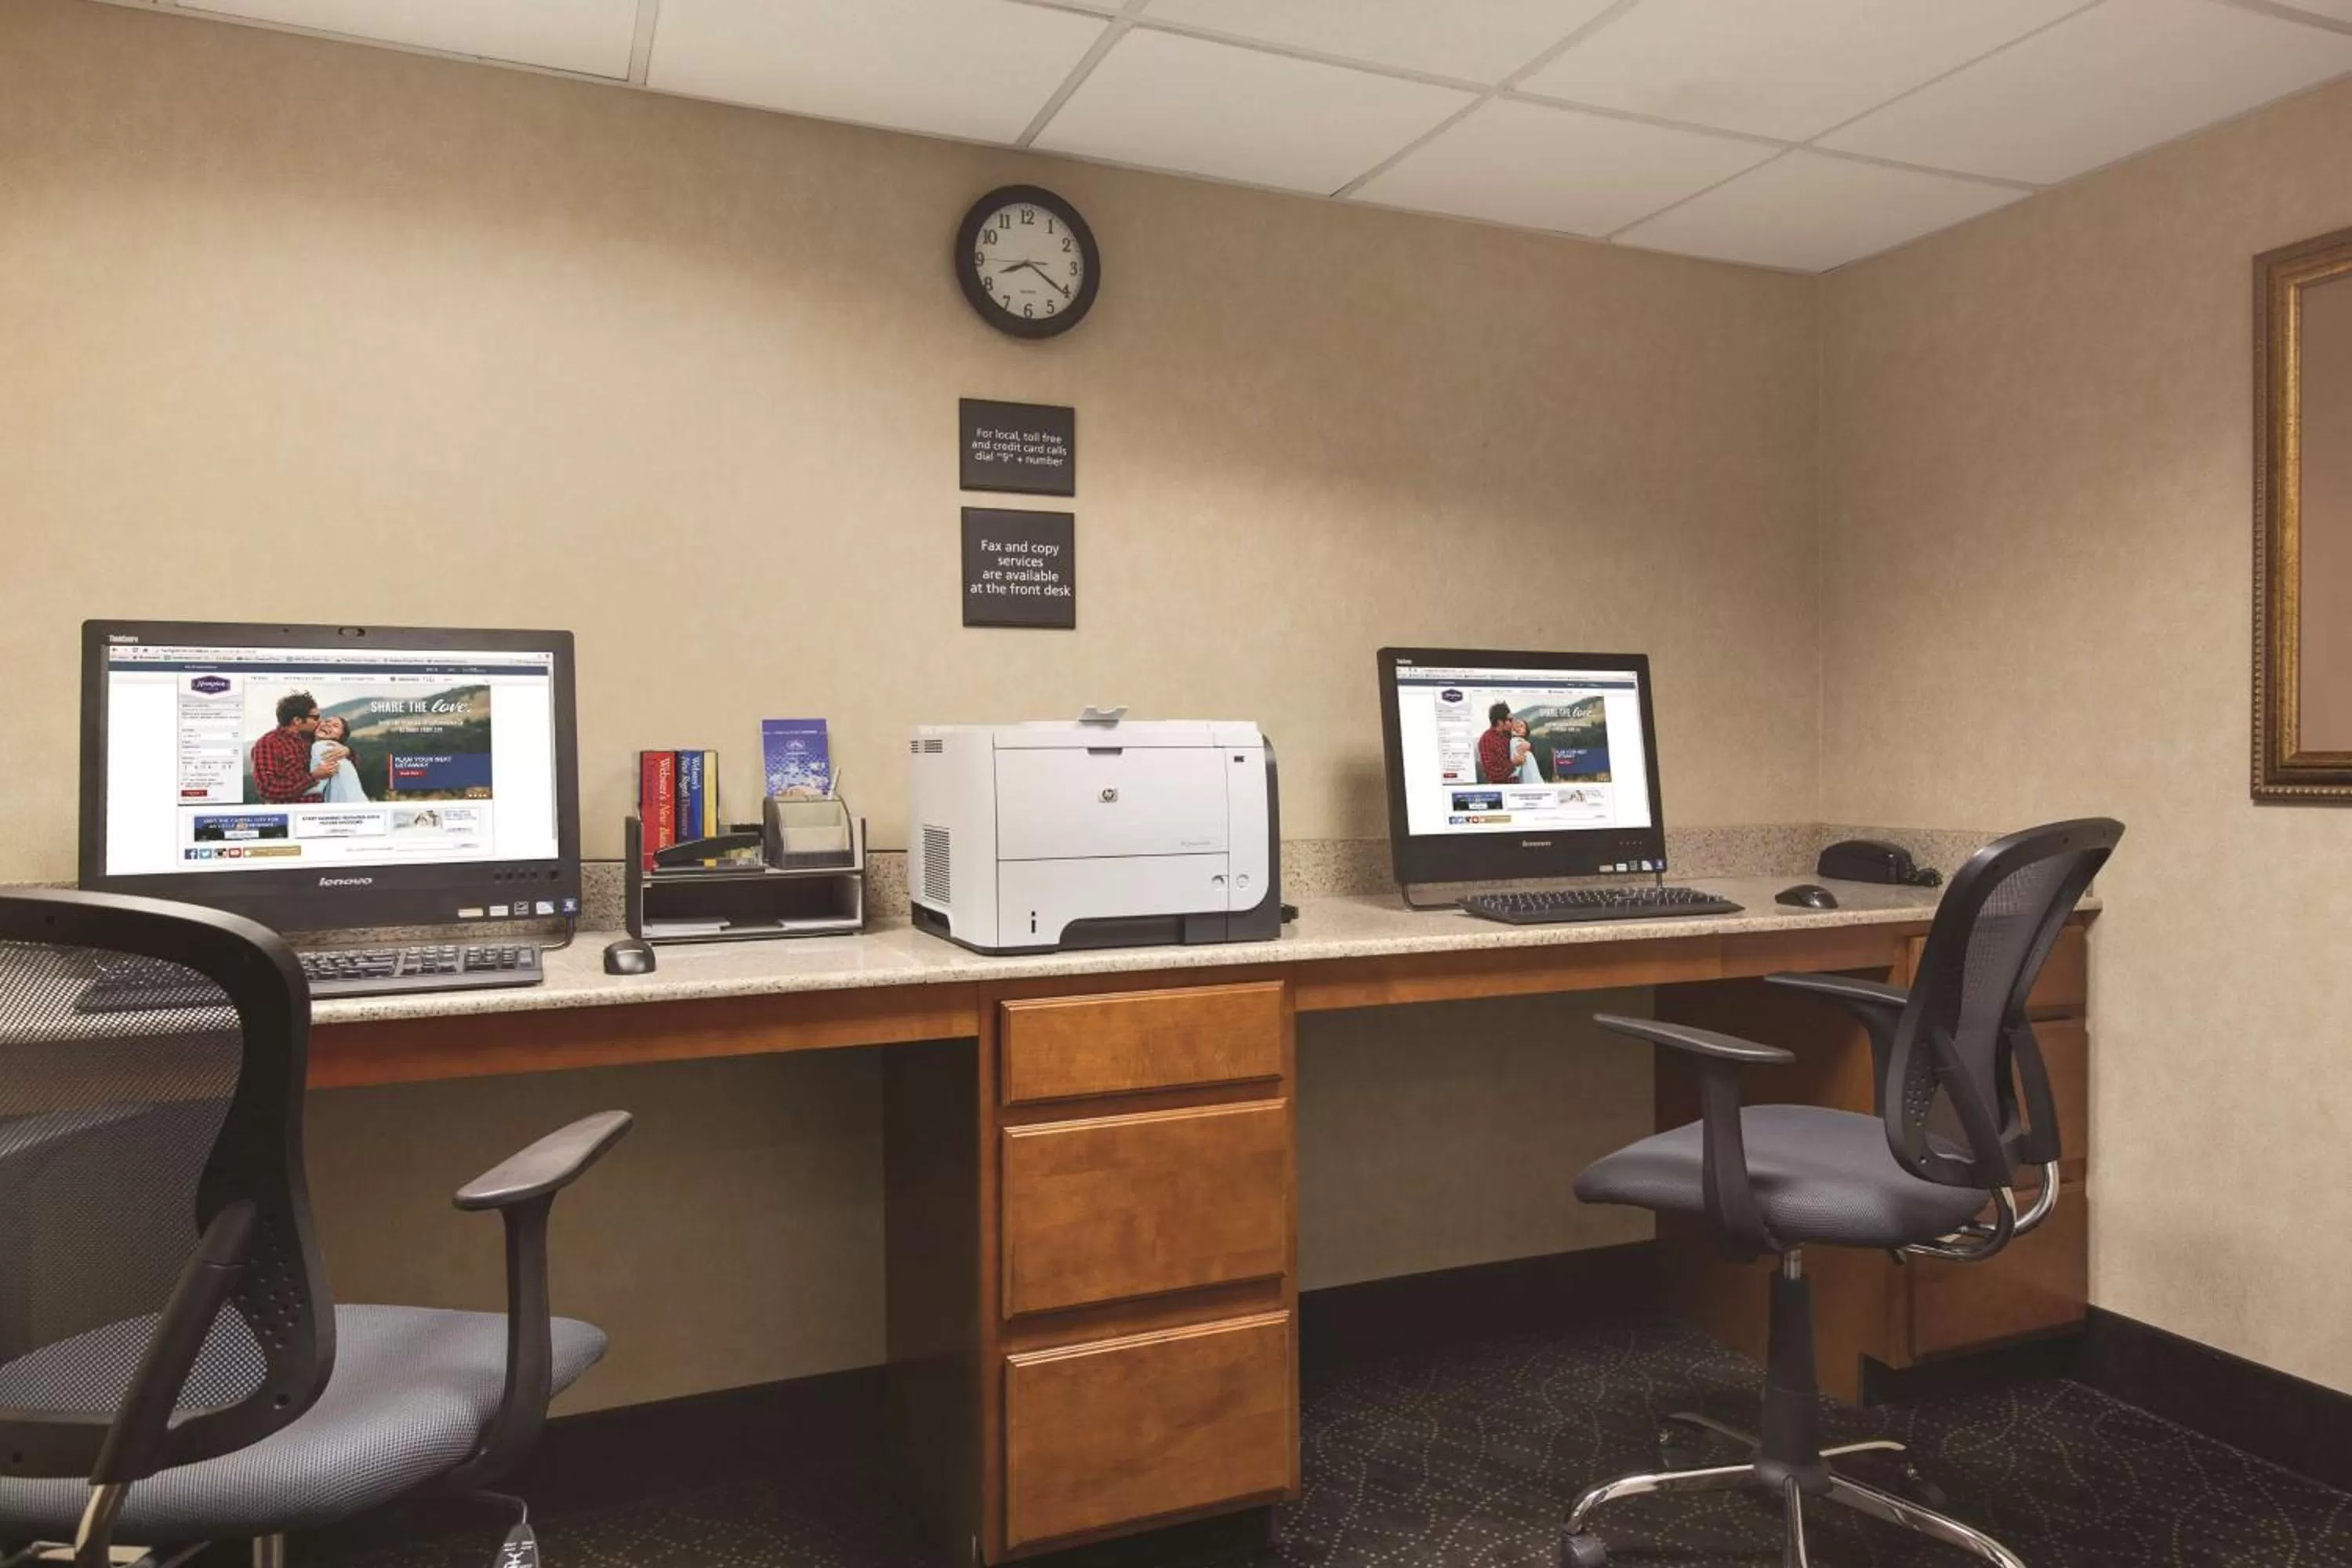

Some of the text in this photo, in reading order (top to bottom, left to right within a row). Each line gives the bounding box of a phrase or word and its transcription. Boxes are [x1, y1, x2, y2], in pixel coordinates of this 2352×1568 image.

[999, 213, 1011, 229] 11
[1020, 209, 1035, 225] 12
[1047, 219, 1054, 234] 1
[982, 229, 998, 245] 10
[1062, 238, 1072, 252] 2
[975, 252, 985, 267] 9
[1069, 261, 1078, 276] 3
[983, 276, 993, 291] 8
[1062, 284, 1070, 299] 4
[1003, 295, 1011, 310] 7
[1046, 299, 1054, 314] 5
[1023, 303, 1033, 318] 6
[976, 428, 993, 438] For
[1023, 431, 1040, 441] toll
[1042, 433, 1062, 444] free
[971, 440, 1067, 456] and credit card calls
[975, 451, 993, 461] dial
[996, 452, 1014, 463] "9"
[1025, 455, 1064, 466] number
[981, 539, 1059, 557] Fax and copy
[997, 556, 1044, 568] services
[982, 570, 1058, 583] are available
[970, 583, 1071, 597] at the front desk
[371, 700, 405, 713] SHARE
[408, 701, 427, 713] THE
[659, 757, 670, 800] Webster's
[659, 802, 671, 825] New
[318, 877, 372, 887] lenovo
